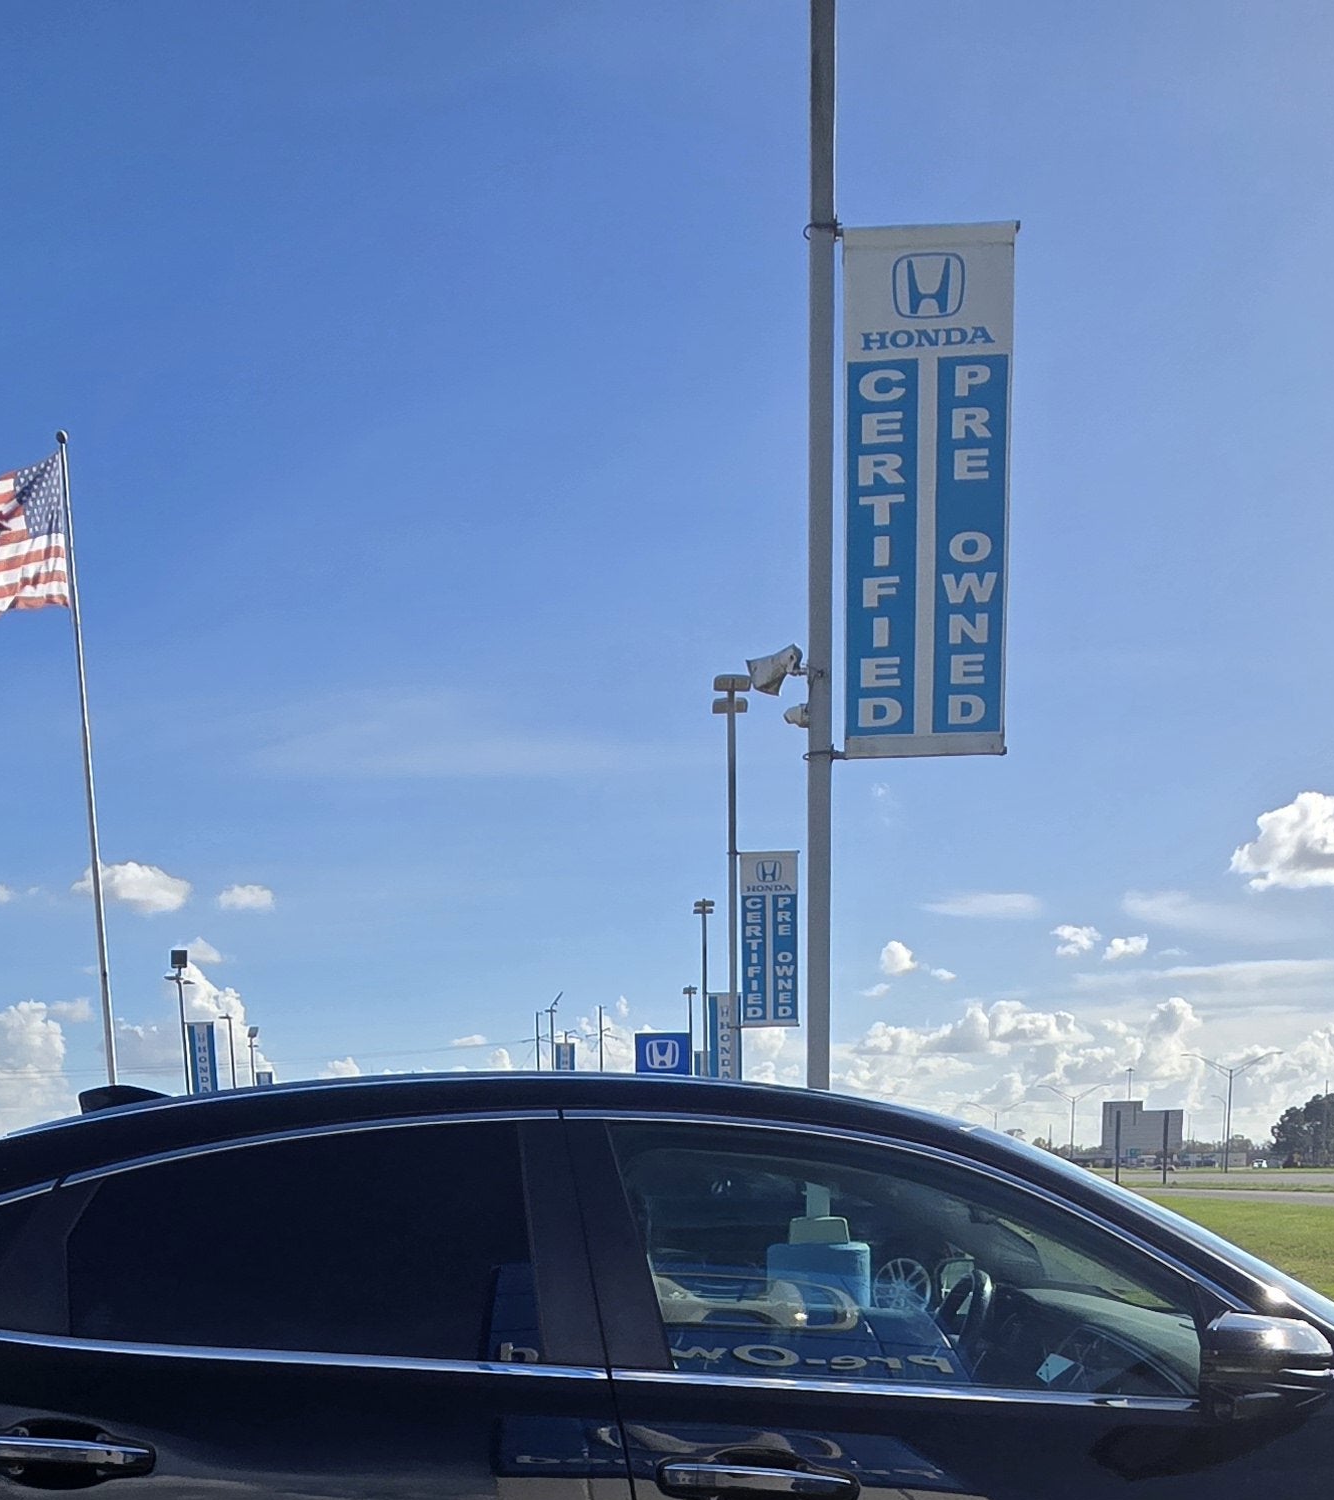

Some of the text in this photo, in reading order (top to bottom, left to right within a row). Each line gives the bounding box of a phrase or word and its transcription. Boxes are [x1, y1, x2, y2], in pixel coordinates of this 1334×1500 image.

[859, 325, 995, 351] HONDA
[857, 369, 906, 728] CERTIFIED
[941, 364, 997, 726] PRE OWNED
[746, 884, 792, 893] HONDA
[745, 897, 763, 1018] CERTIFIED
[774, 896, 795, 1017] PRE OWNED
